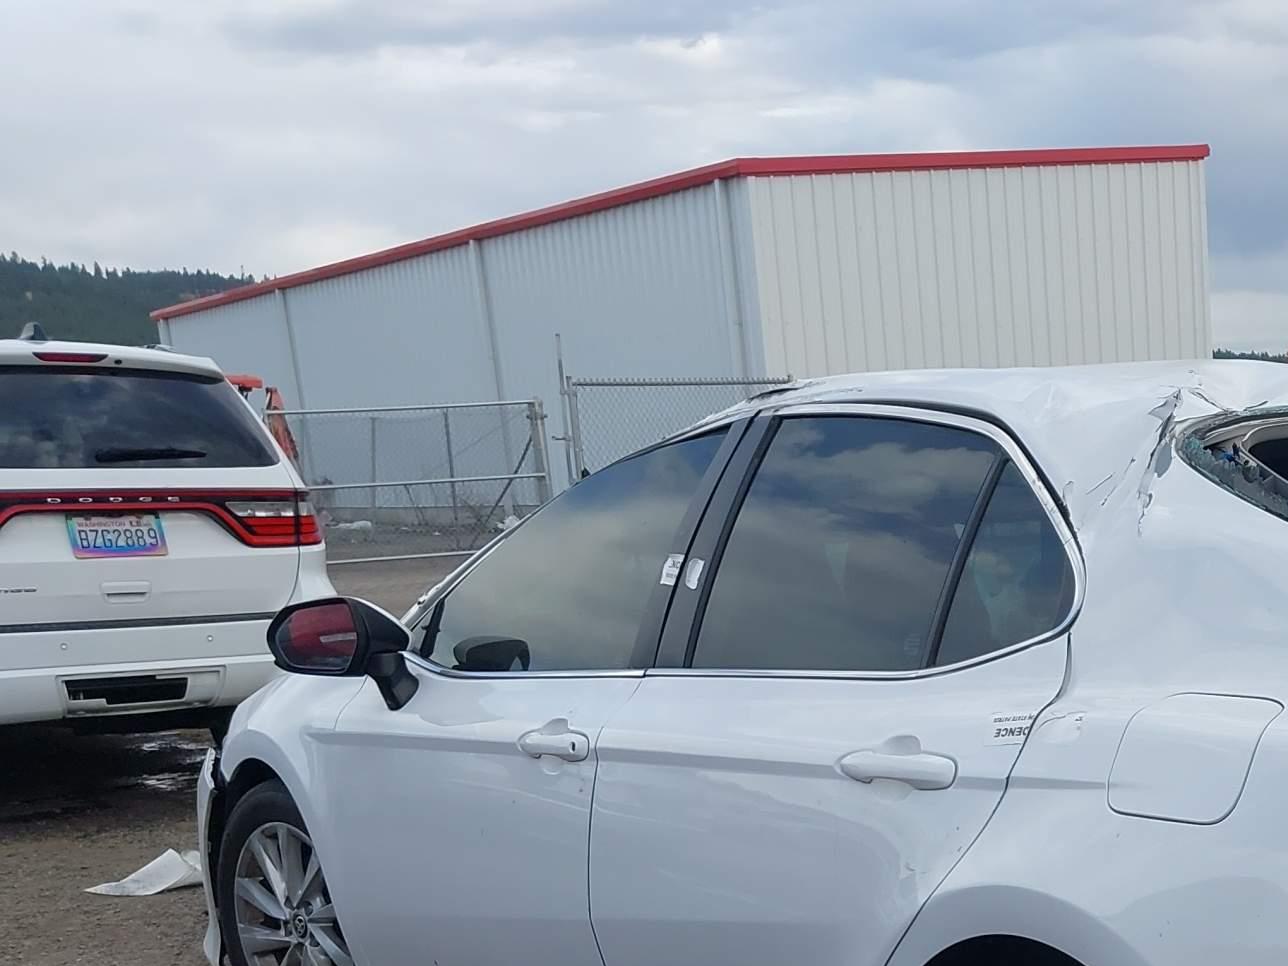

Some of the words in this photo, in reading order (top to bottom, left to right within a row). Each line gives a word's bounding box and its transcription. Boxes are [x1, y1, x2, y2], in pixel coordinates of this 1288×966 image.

[46, 496, 181, 504] DODGE
[77, 520, 126, 528] WASHINGTON
[77, 527, 159, 549] BZG2889
